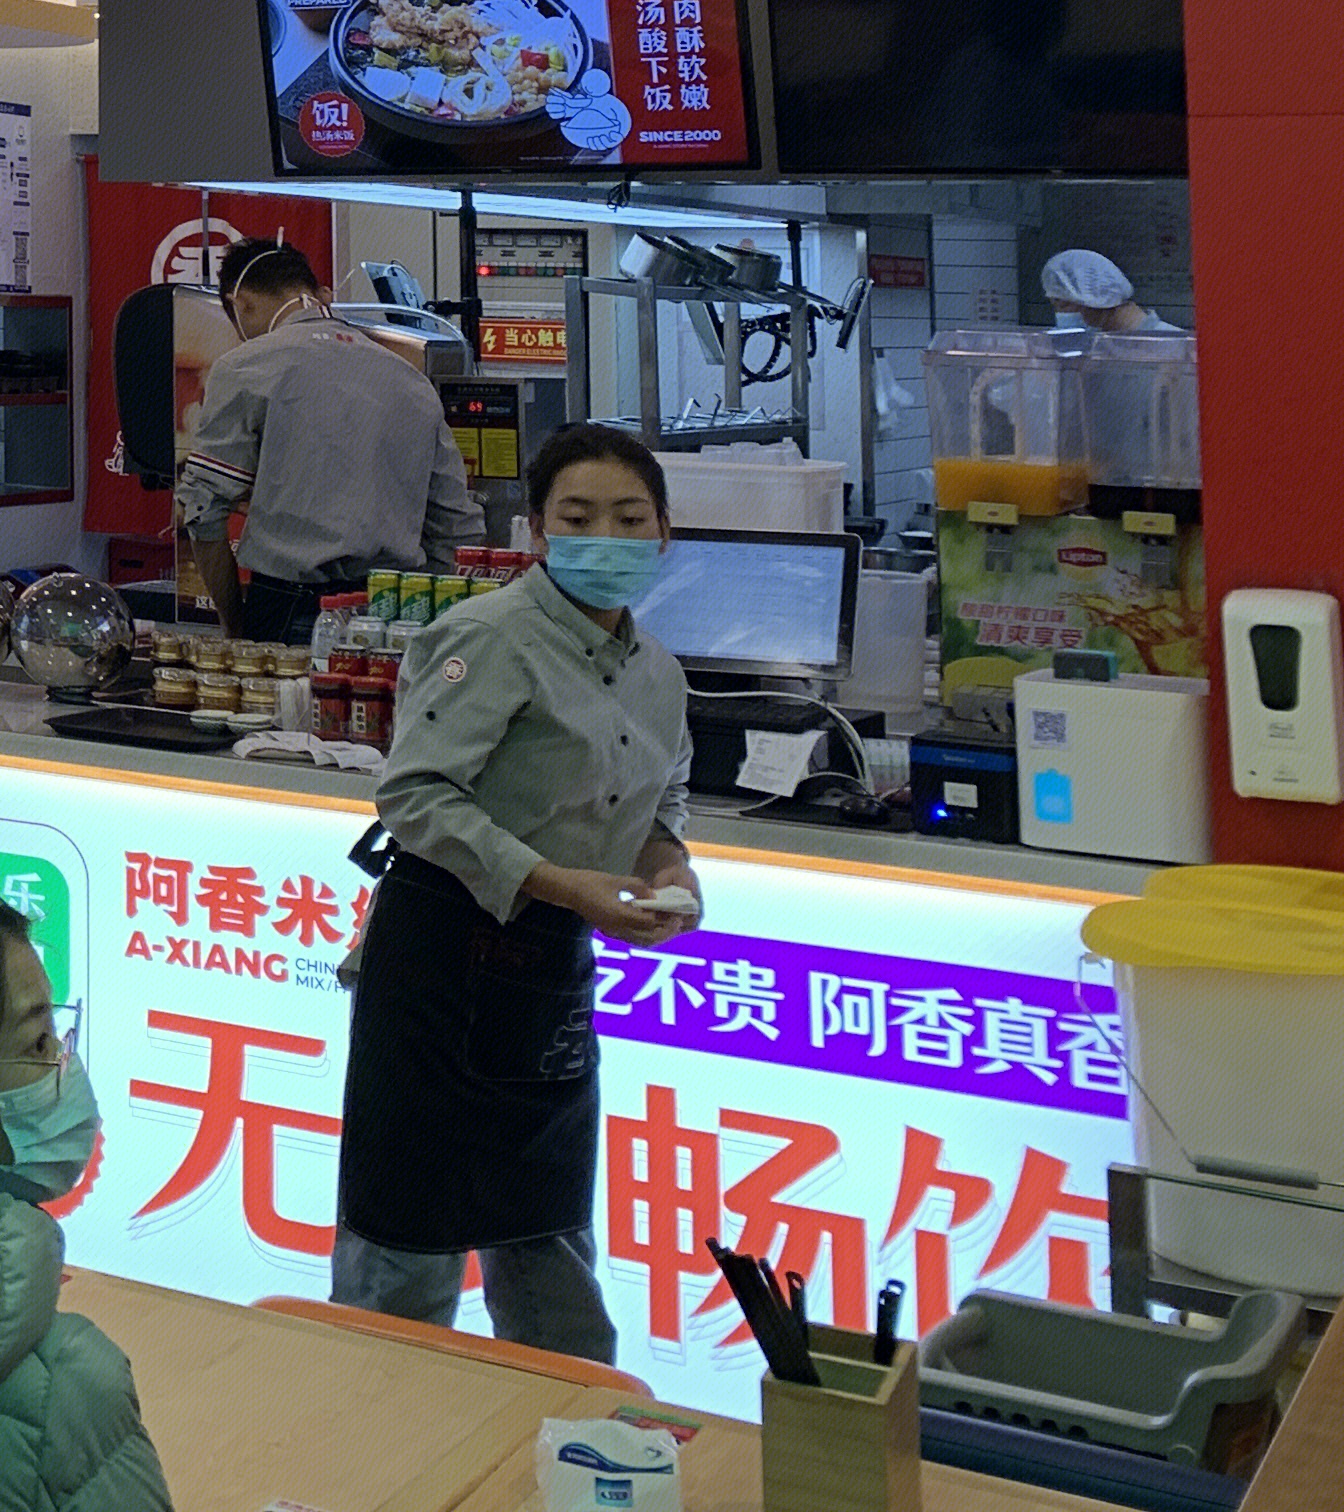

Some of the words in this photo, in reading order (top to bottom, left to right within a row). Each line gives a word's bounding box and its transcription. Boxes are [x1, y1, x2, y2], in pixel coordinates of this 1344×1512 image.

[312, 100, 348, 127] 饭!
[505, 328, 566, 347] 当心触电
[125, 930, 289, 983] A-XIANG
[809, 971, 1129, 1095] 阿香真香
